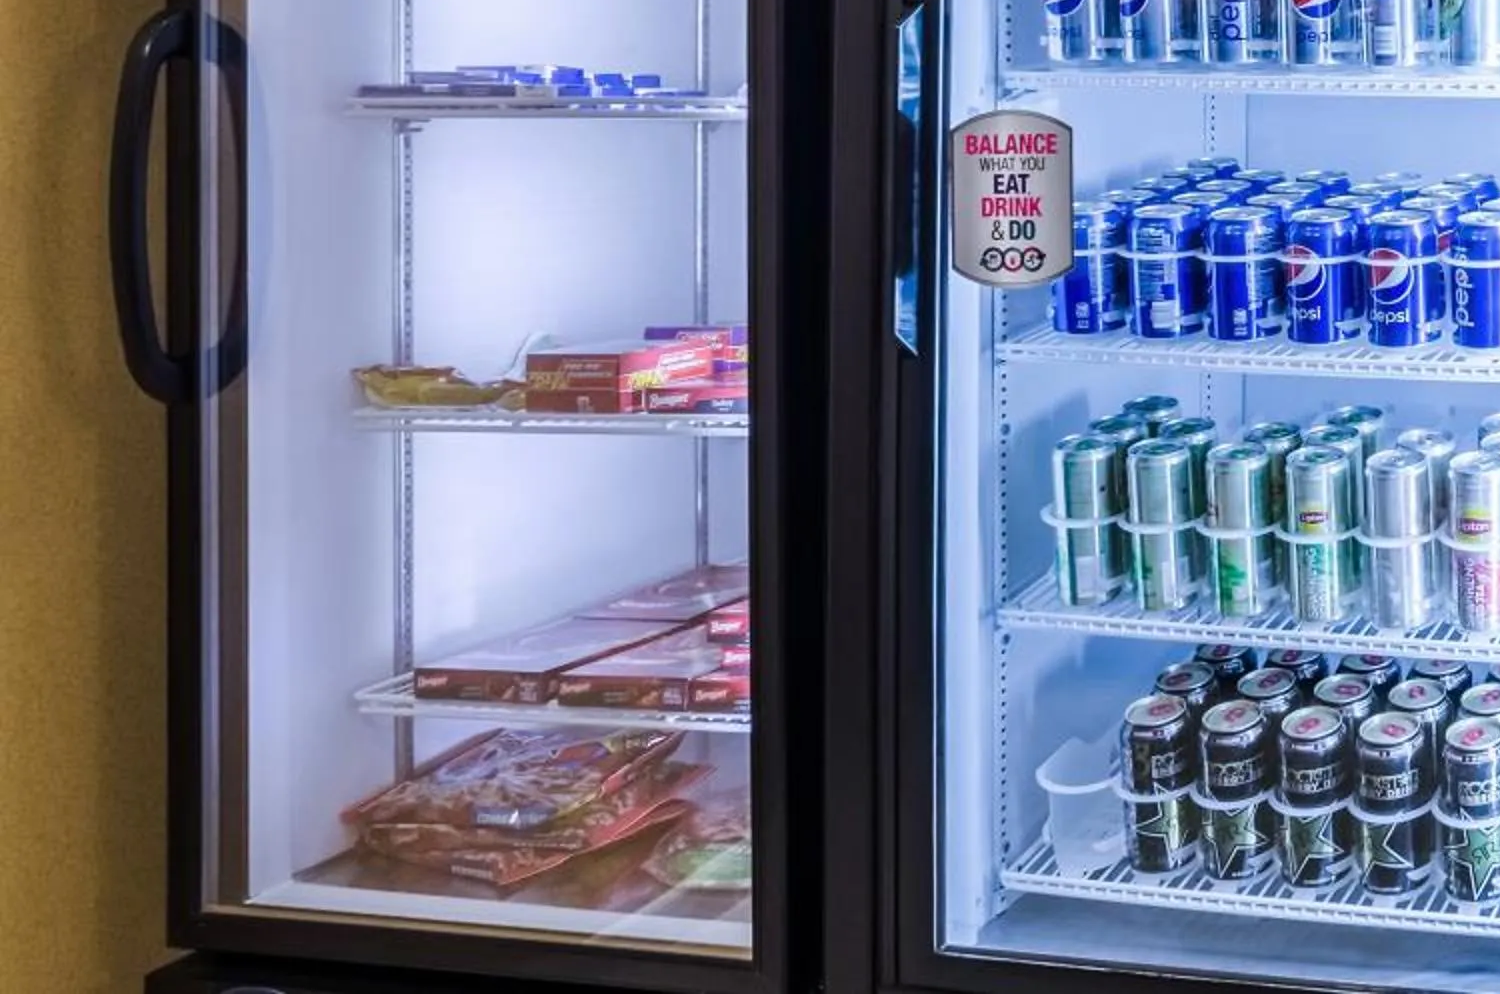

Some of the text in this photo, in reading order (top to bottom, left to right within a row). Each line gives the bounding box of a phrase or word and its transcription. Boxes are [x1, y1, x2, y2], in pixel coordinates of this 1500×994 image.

[965, 133, 1058, 155] BALANCE
[980, 156, 1045, 171] WHAT YOU
[981, 197, 1043, 218] DRINK
[991, 220, 1036, 241] & DO
